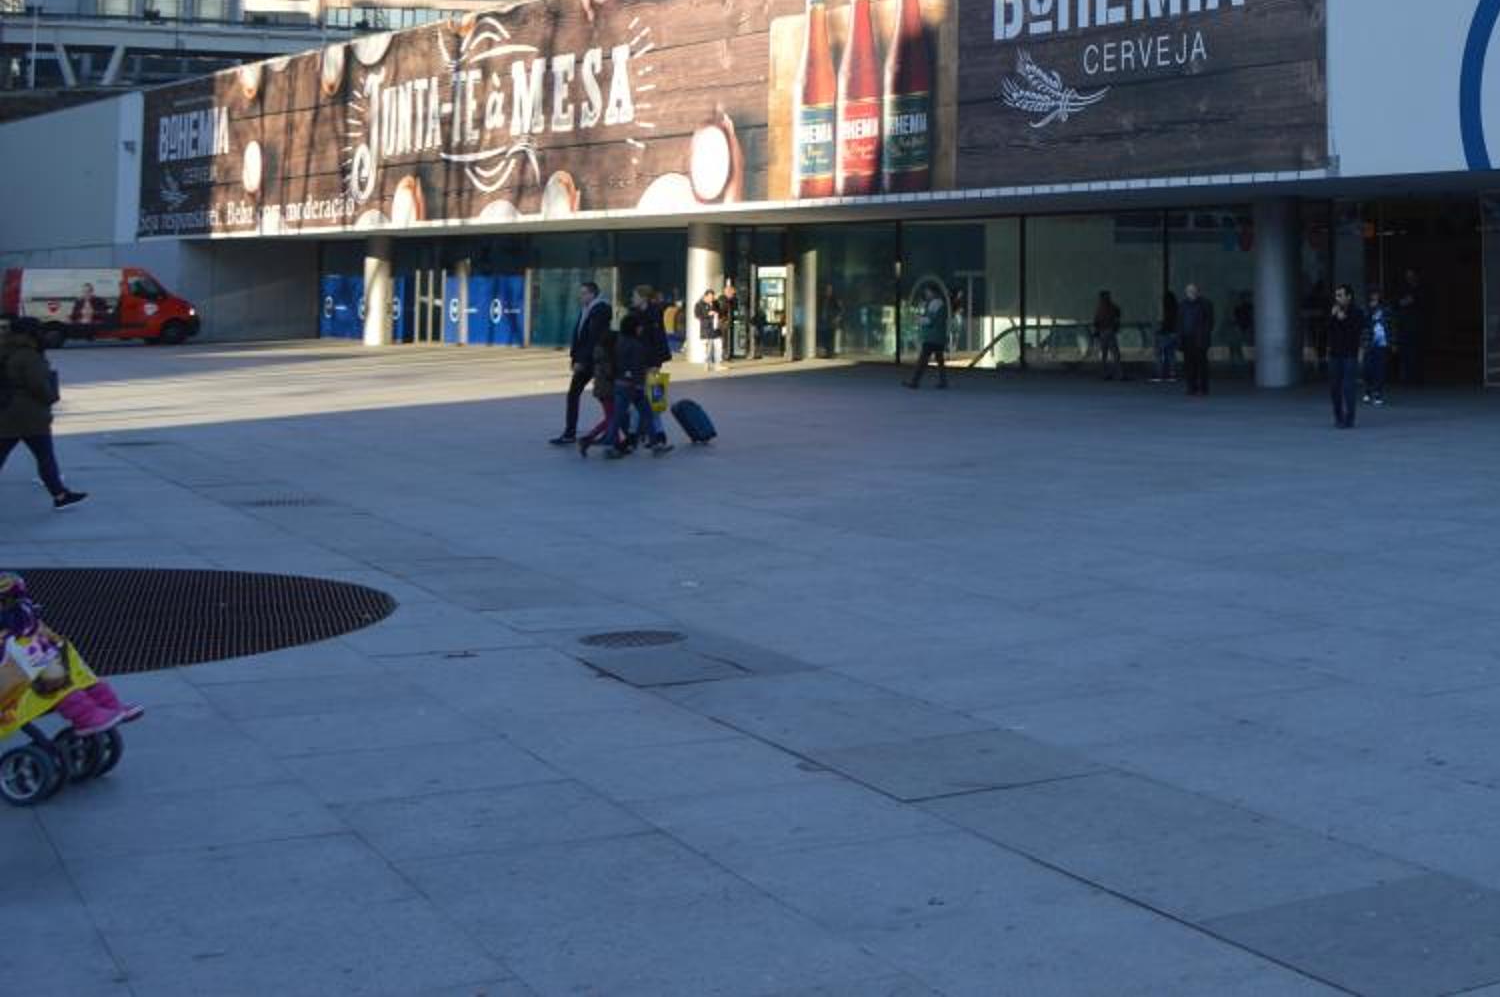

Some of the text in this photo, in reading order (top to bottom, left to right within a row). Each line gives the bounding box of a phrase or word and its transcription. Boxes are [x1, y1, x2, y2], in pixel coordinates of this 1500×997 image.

[1083, 31, 1208, 75] CERVEJA
[510, 43, 635, 136] MESA
[160, 106, 230, 162] BOHEMIA
